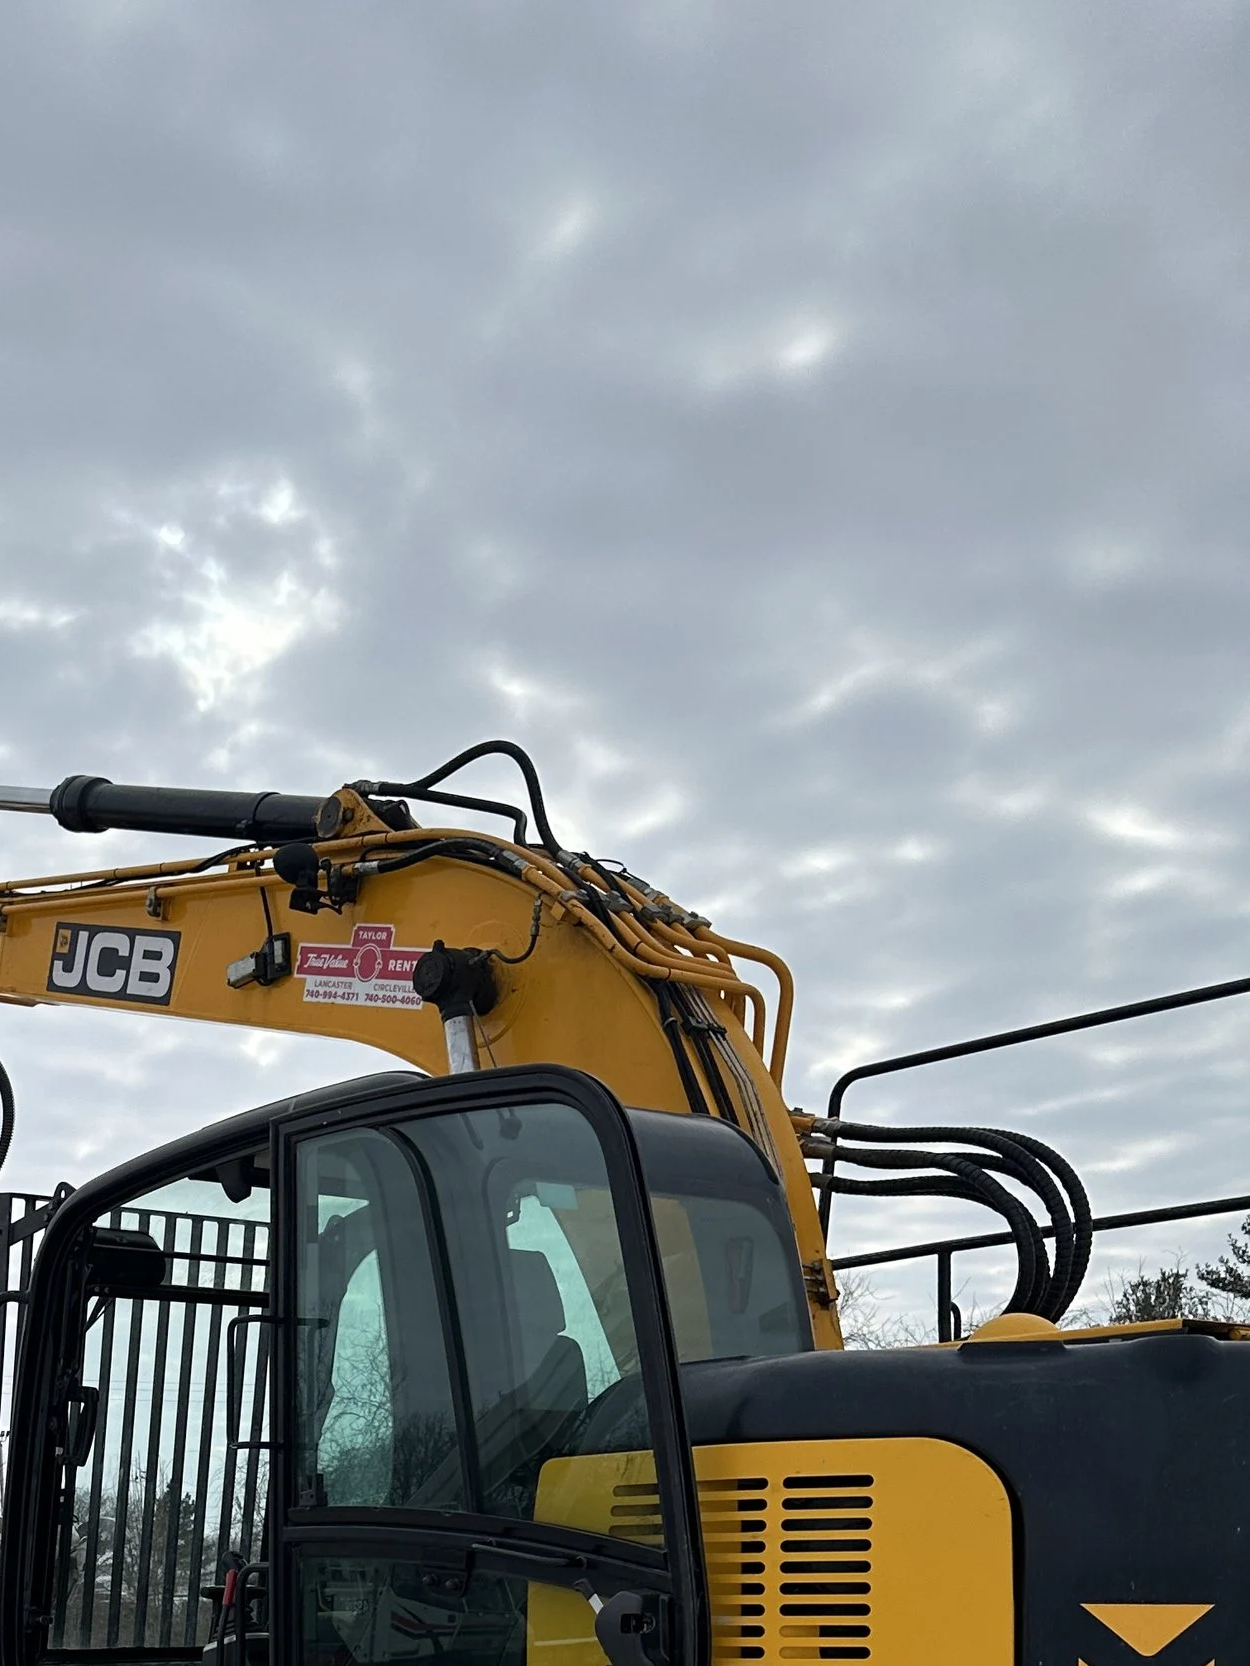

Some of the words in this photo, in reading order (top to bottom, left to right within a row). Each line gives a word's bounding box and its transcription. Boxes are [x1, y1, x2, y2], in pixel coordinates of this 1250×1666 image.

[358, 930, 388, 941] TAYLOR
[52, 930, 174, 998] JCB
[388, 959, 417, 972] RENT
[314, 979, 353, 990] LANCASTER
[305, 989, 359, 1001] 740-994-4371
